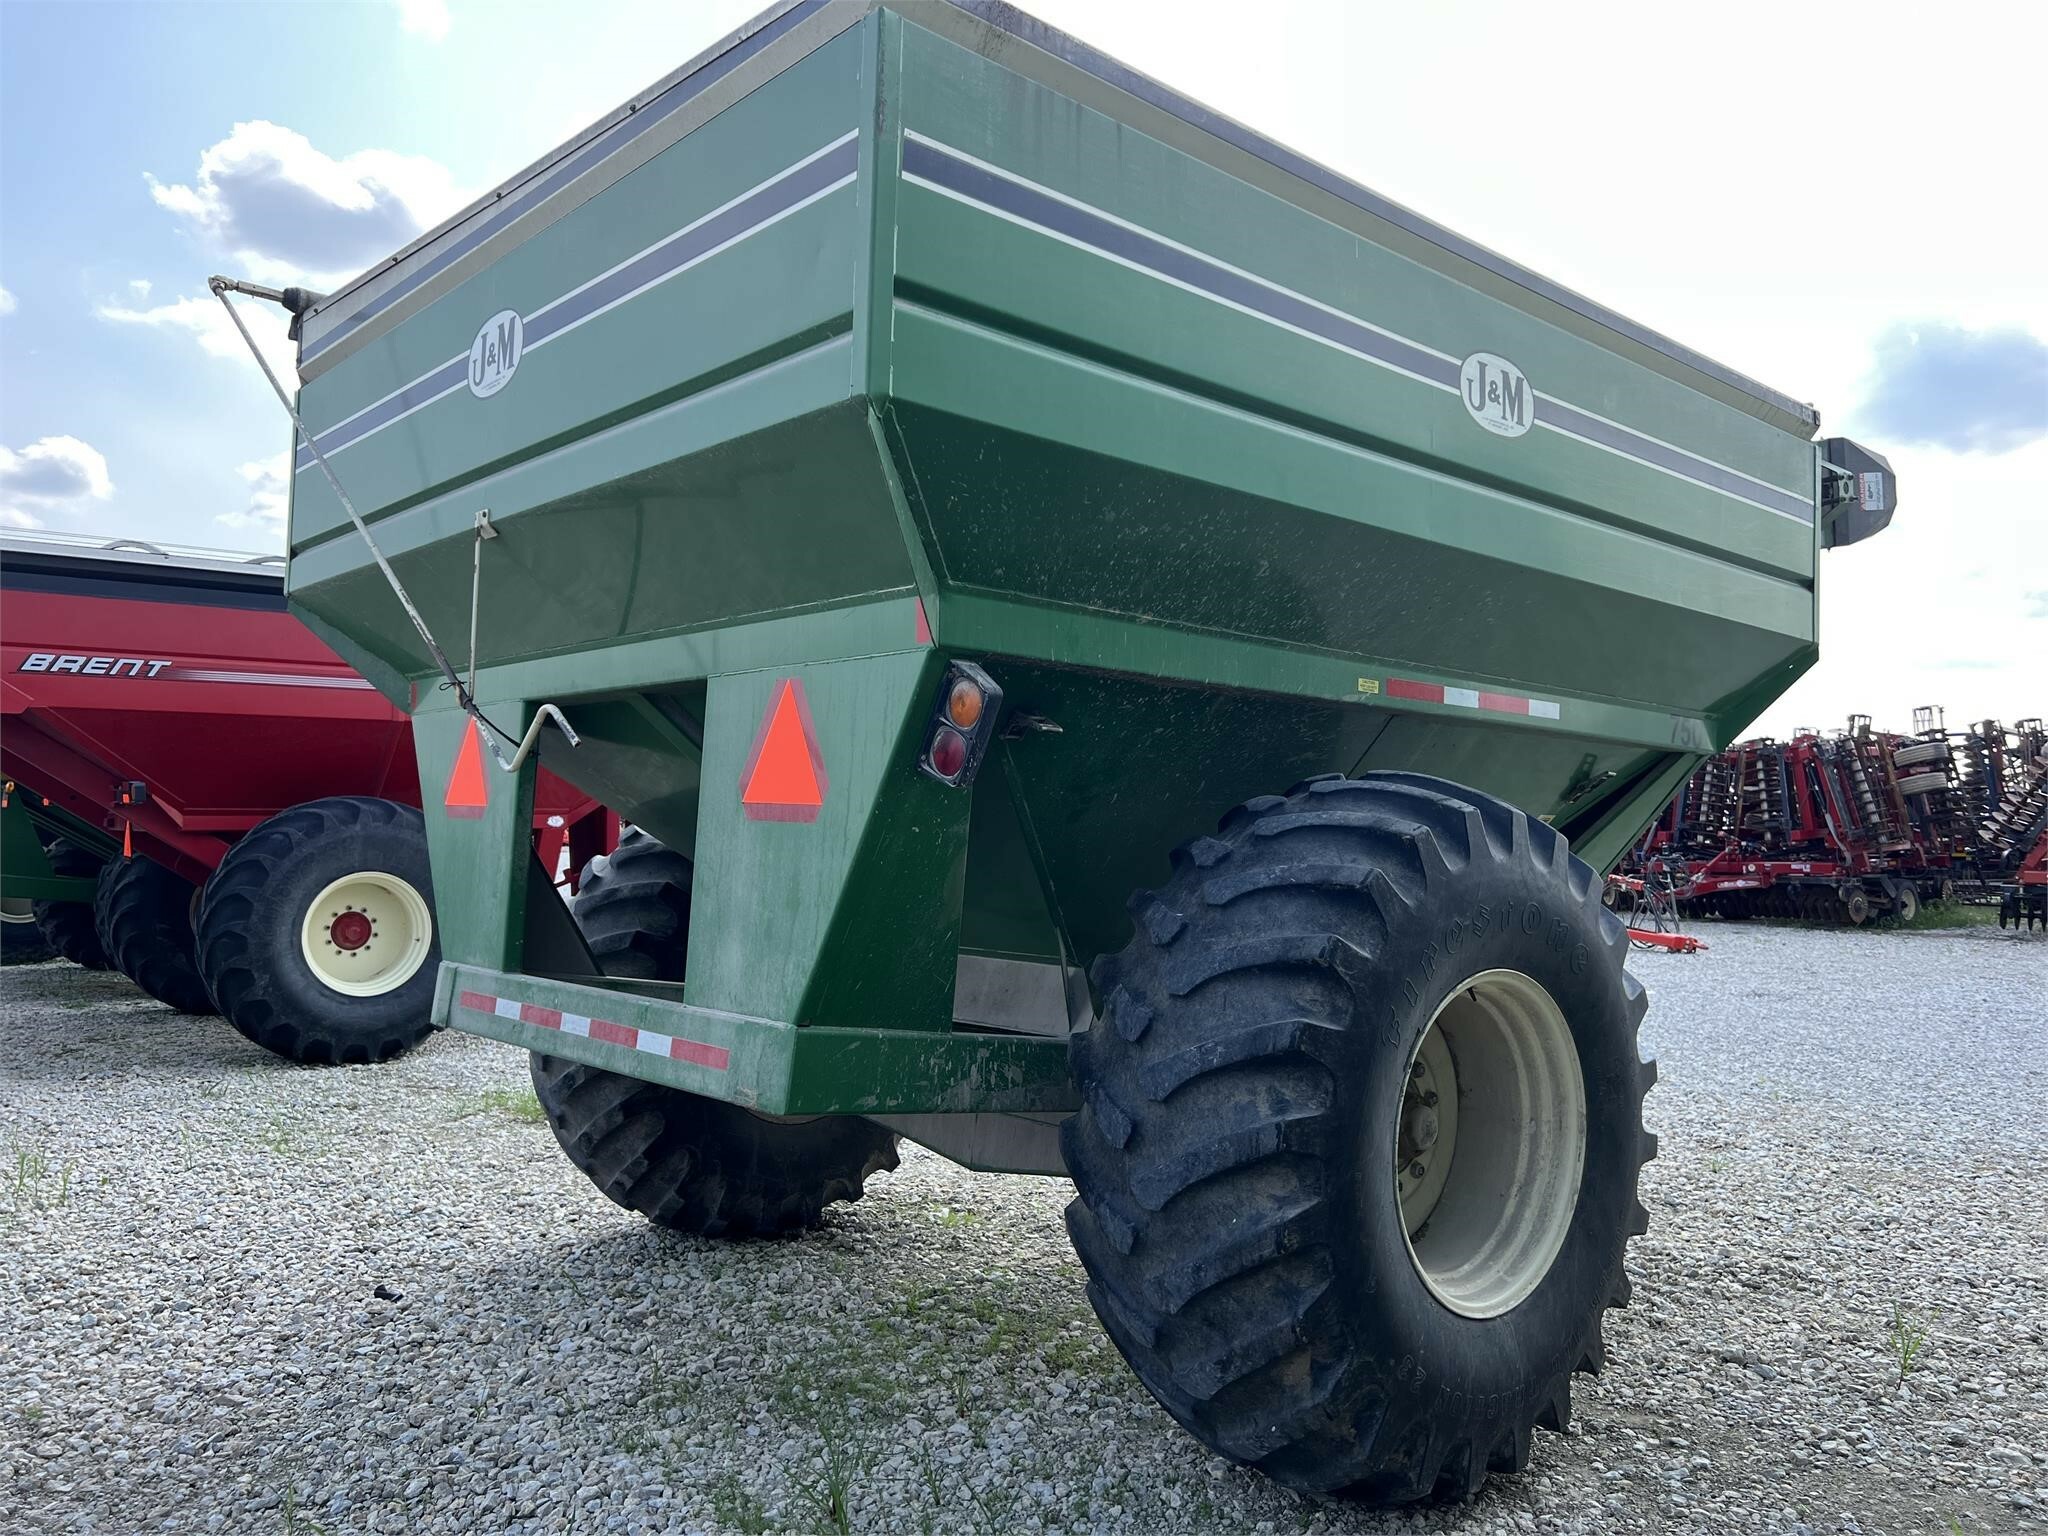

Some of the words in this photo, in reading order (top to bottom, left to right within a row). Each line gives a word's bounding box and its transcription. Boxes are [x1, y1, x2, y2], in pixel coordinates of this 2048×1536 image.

[472, 315, 517, 387] J&M
[1466, 360, 1525, 427] J&M
[20, 653, 173, 677] BRENT
